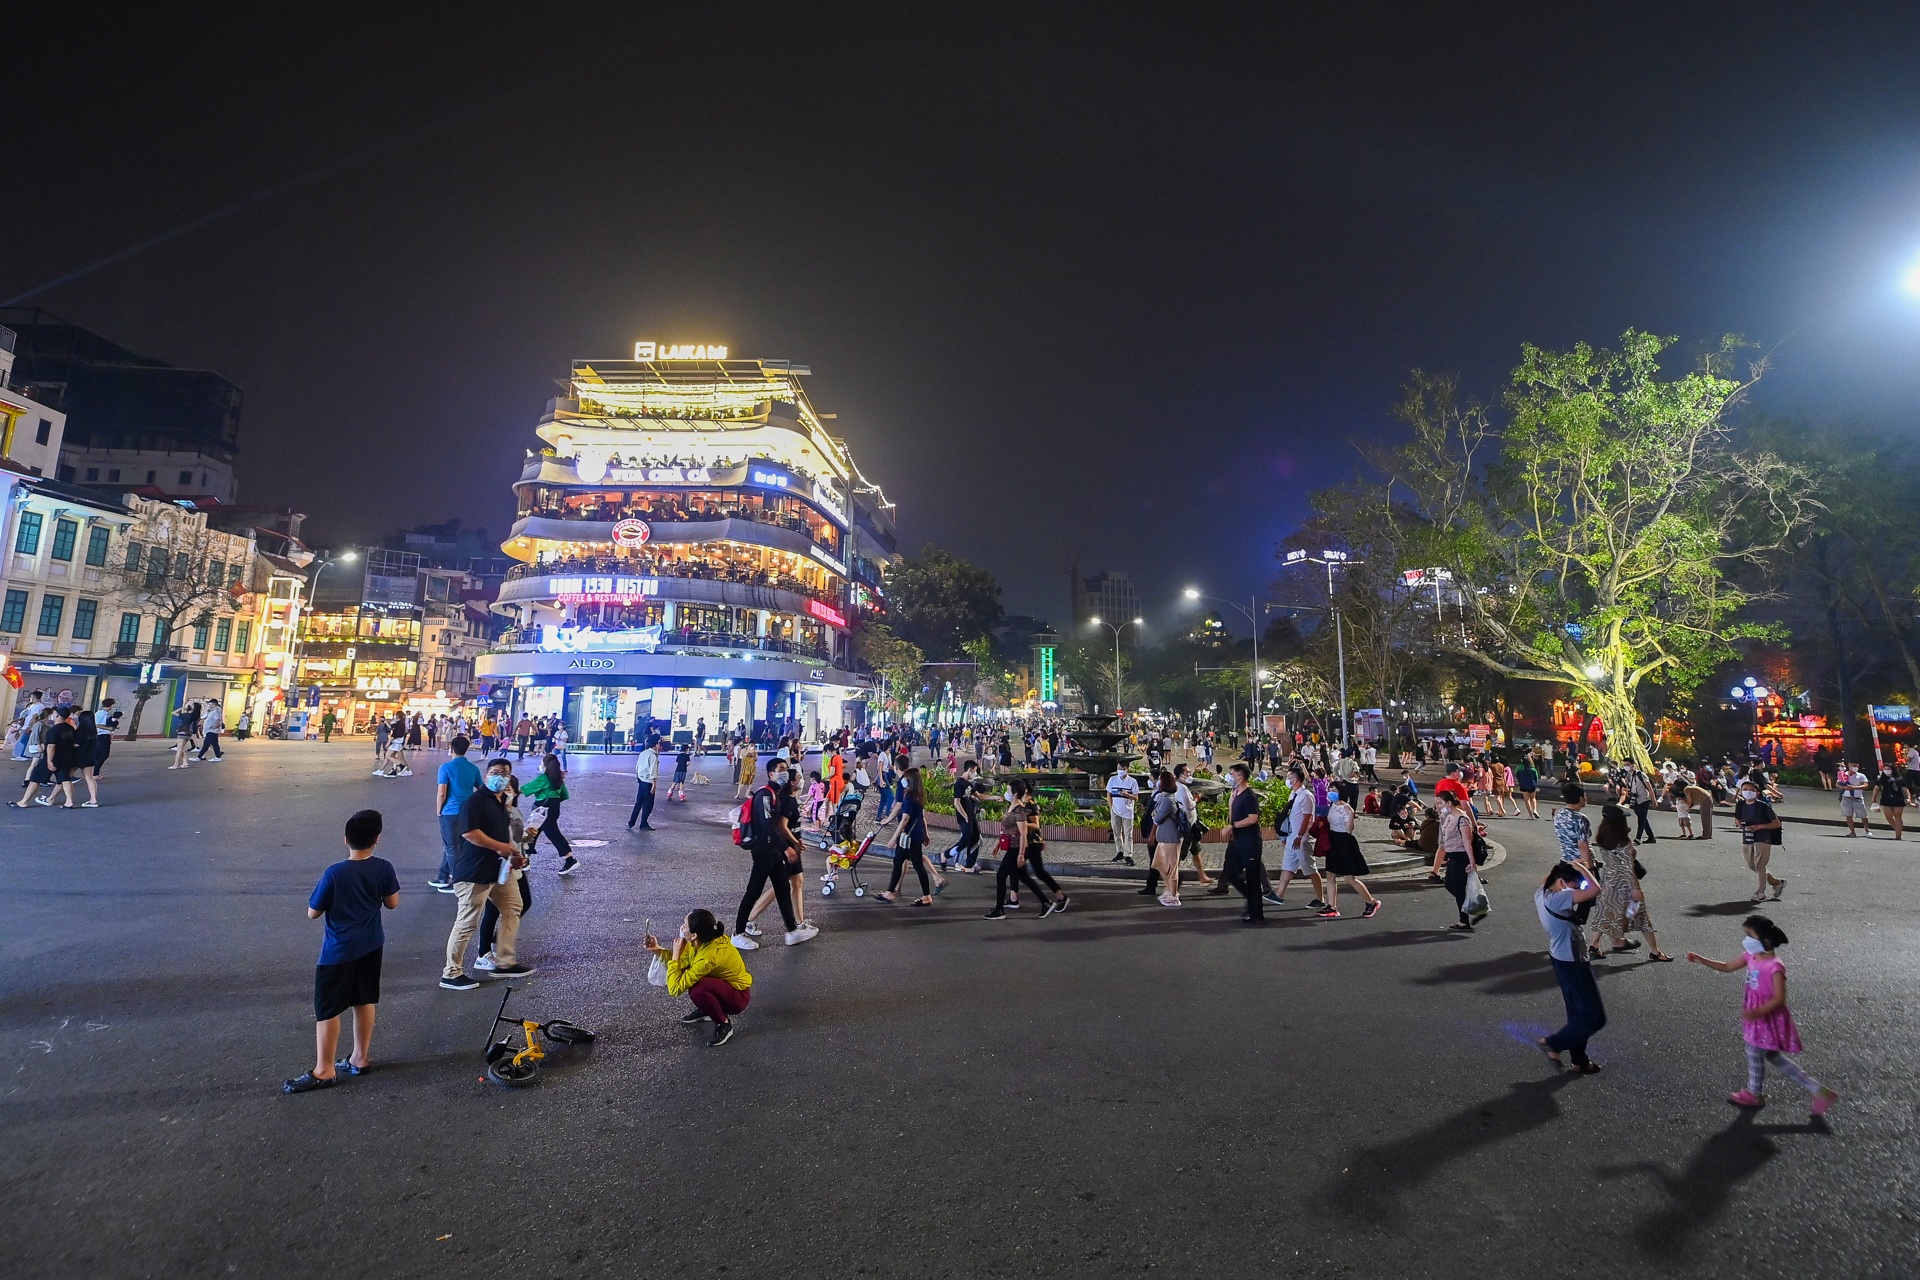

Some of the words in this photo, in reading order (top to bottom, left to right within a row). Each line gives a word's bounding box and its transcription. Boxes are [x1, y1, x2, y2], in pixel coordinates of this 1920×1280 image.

[558, 594, 585, 602] COFFEE
[587, 594, 592, 602] &
[568, 658, 615, 670] ALDO
[703, 678, 733, 687] ALDO
